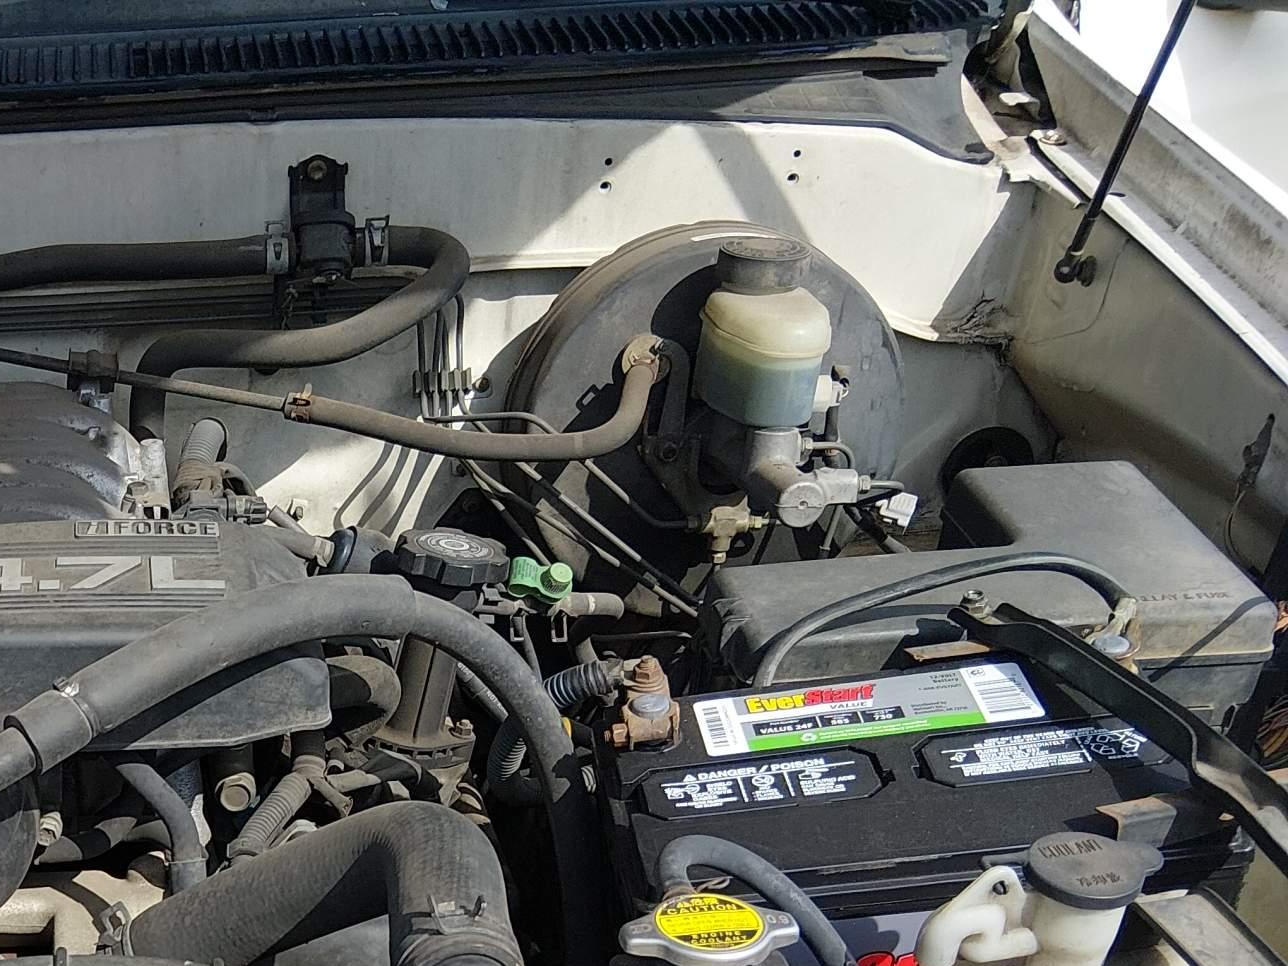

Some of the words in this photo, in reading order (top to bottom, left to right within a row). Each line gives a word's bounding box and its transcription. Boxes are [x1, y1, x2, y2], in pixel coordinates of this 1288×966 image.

[744, 684, 874, 714] EverStart
[829, 701, 868, 710] VALUE
[759, 725, 793, 735] VALUE
[697, 767, 757, 780] DANGER
[770, 758, 825, 772] POISON
[1039, 839, 1103, 859] COOLANT
[667, 903, 737, 915] CAUTION
[690, 935, 748, 945] COOLANT
[692, 930, 741, 940] ENGINE
